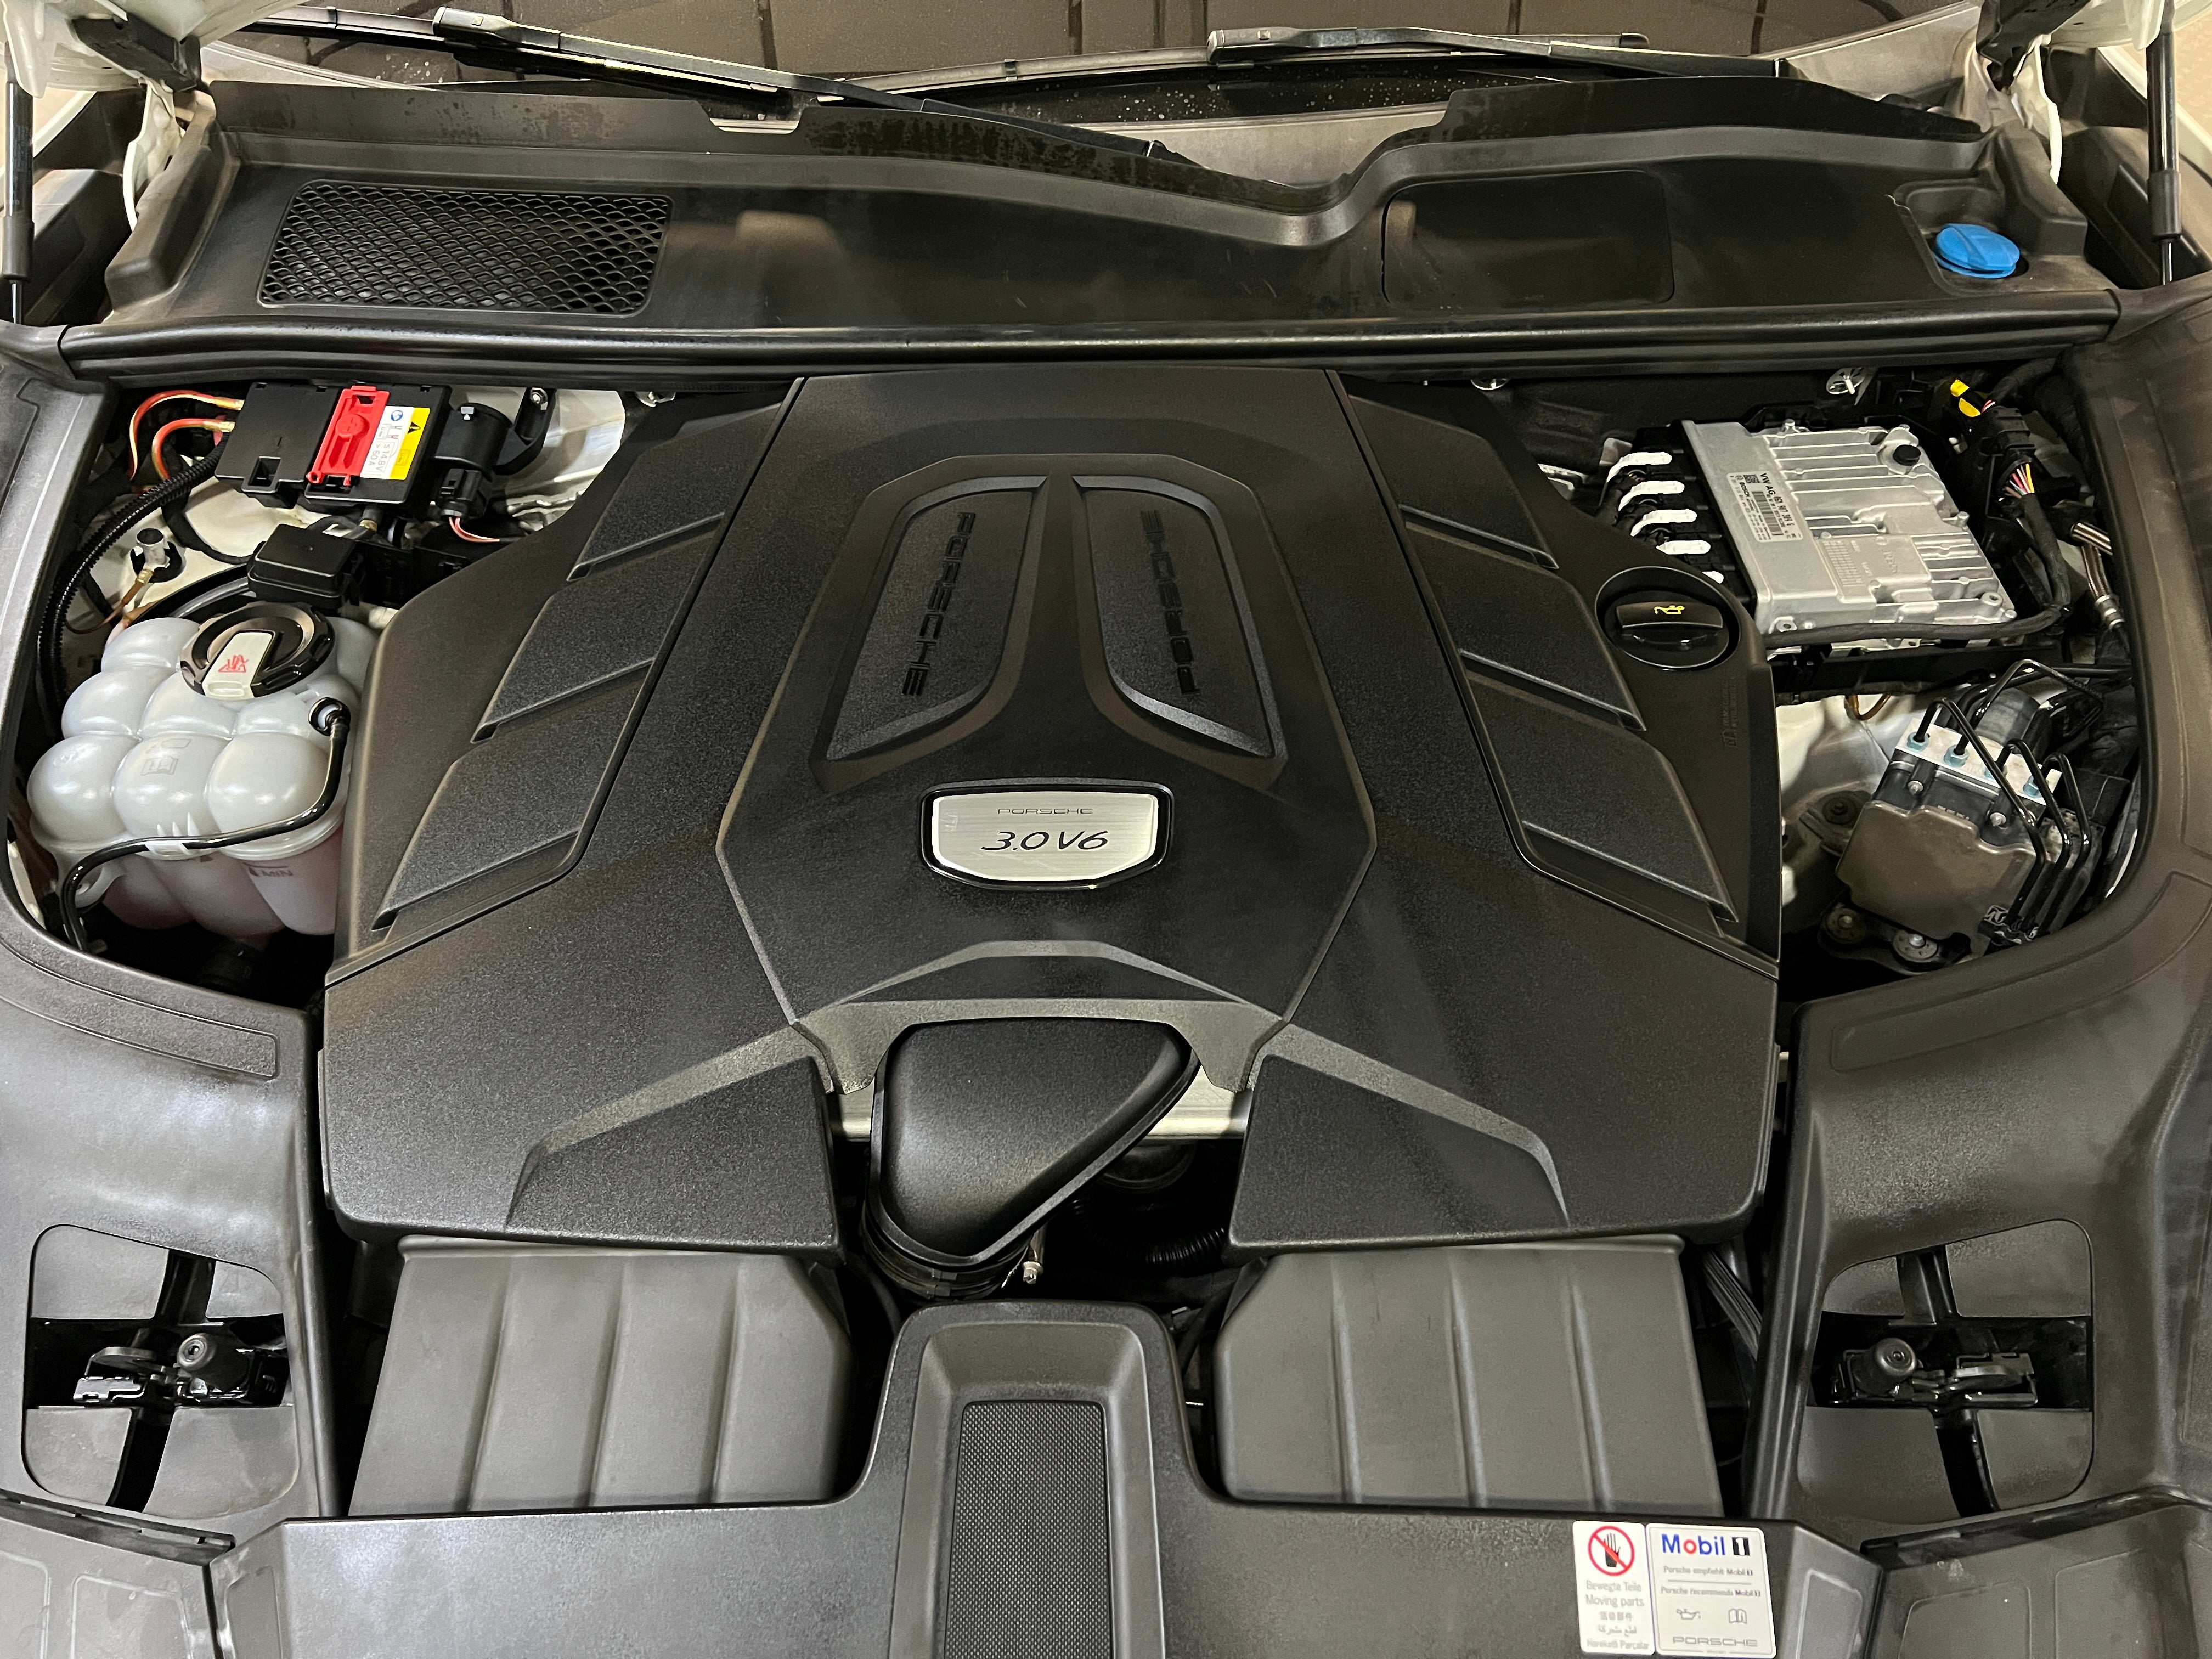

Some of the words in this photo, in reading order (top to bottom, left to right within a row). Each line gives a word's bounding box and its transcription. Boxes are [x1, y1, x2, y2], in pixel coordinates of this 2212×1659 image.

[1760, 473, 1771, 484] VW
[1765, 486, 1776, 495] AG
[902, 512, 975, 696] PORSCHE
[1141, 510, 1200, 694] PORSCHE
[980, 832, 1049, 851] 3.0
[1058, 831, 1108, 850] V6
[1661, 1534, 1725, 1556] Mobil
[1734, 1537, 1748, 1556] 1
[1585, 1594, 1618, 1608] Moving
[1621, 1597, 1645, 1608] parts
[1672, 1636, 1758, 1647] PORSCHE
